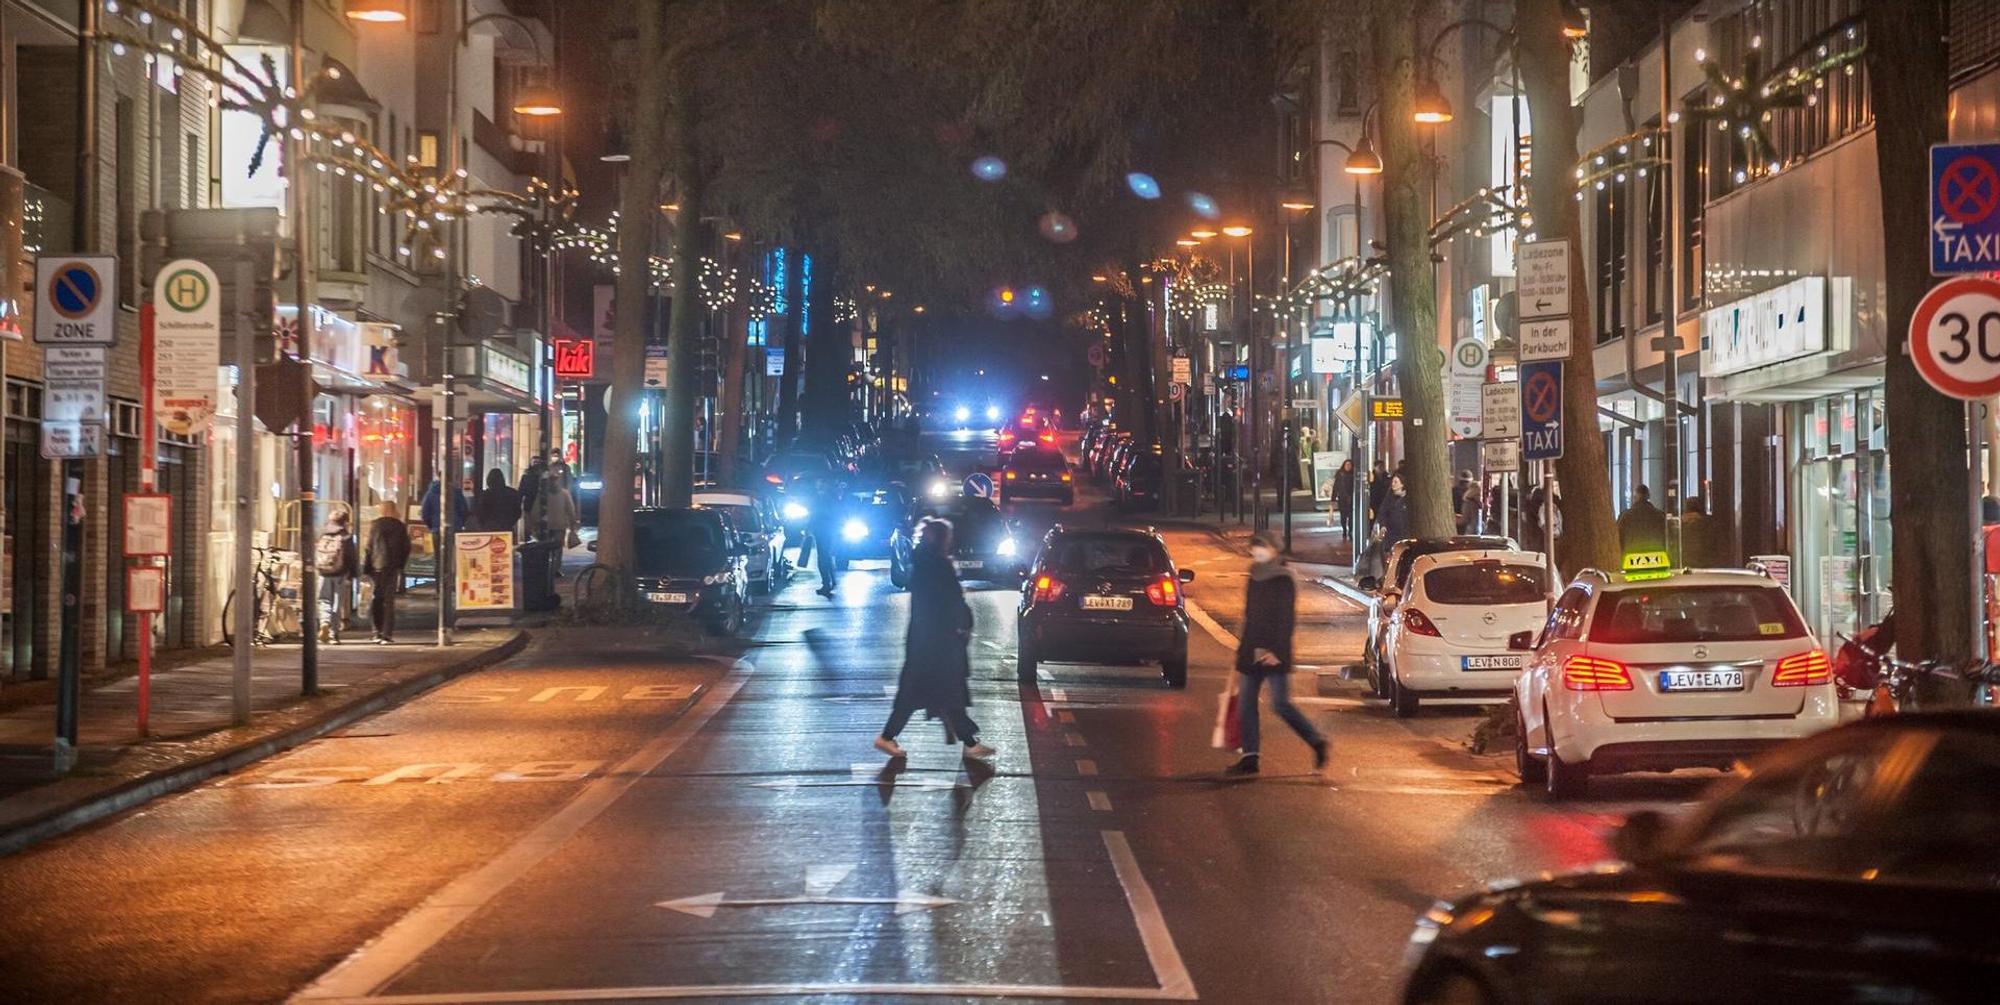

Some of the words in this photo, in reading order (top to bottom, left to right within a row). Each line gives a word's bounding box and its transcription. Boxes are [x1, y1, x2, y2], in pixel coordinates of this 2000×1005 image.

[1522, 247, 1564, 260] Ladezone
[1940, 233, 2000, 263] TAXI
[54, 323, 95, 338] ZONE
[1542, 326, 1558, 337] der
[1939, 312, 2000, 364] 30
[1522, 341, 1567, 355] Parkbucht
[1485, 387, 1515, 396] Ladezone
[1525, 430, 1559, 451] TAXI
[1630, 556, 1663, 565] TAXI
[1468, 658, 1488, 667] LEV
[1493, 657, 1501, 667] N
[1502, 657, 1520, 667] 808
[1668, 674, 1695, 687] LEV
[1704, 673, 1722, 686] EA
[1724, 672, 1741, 685] 78
[440, 685, 701, 703] BUS
[244, 760, 607, 789] BUS
